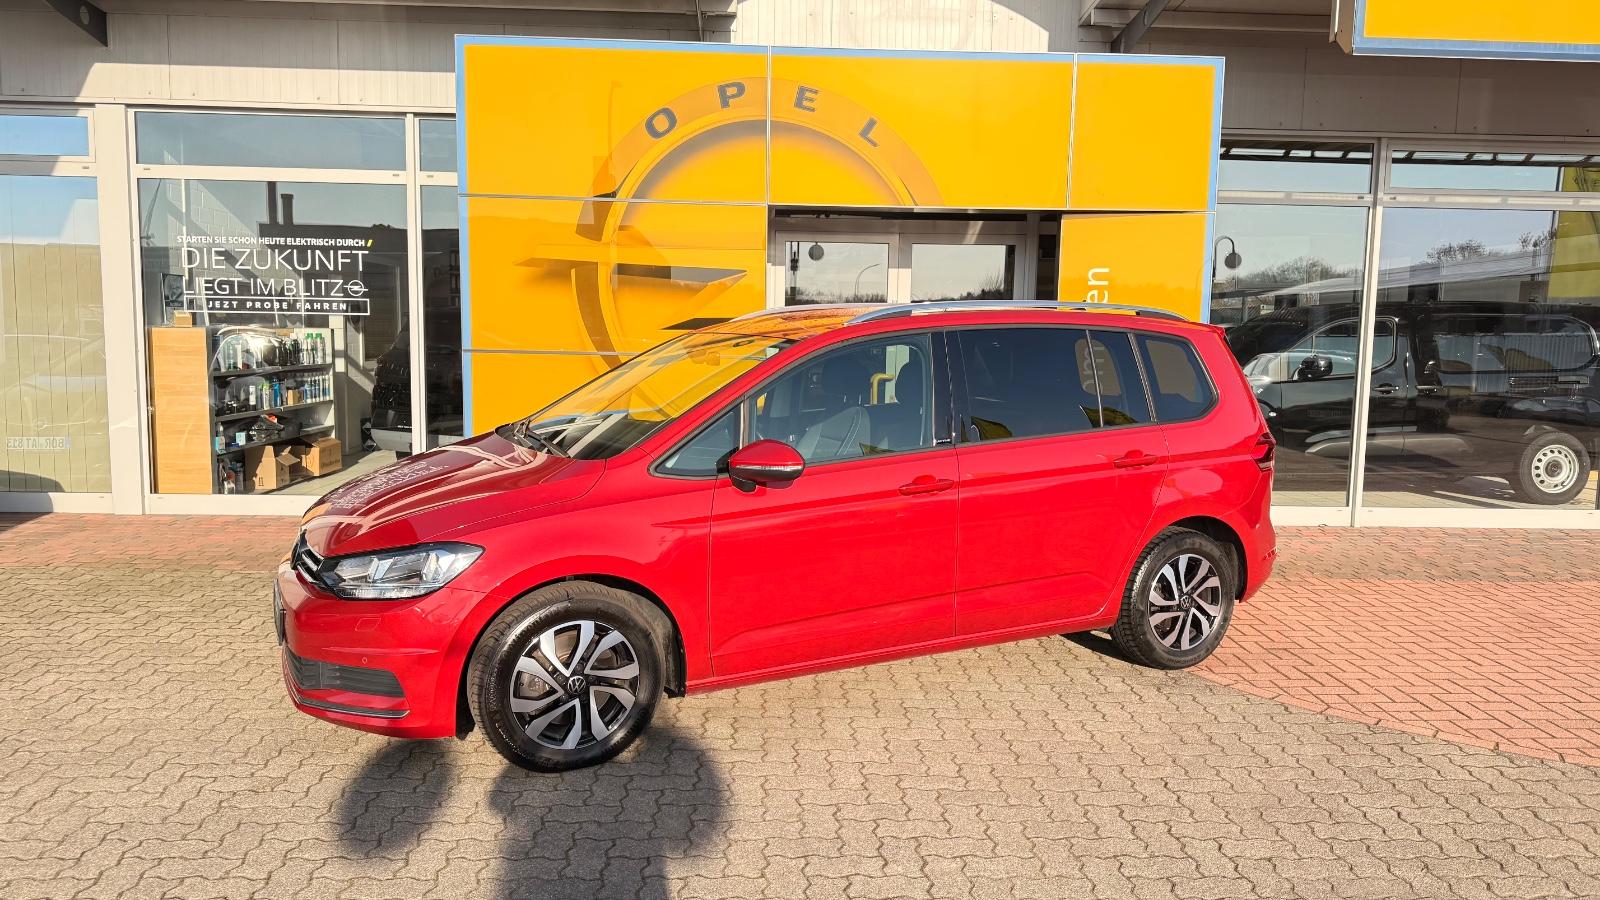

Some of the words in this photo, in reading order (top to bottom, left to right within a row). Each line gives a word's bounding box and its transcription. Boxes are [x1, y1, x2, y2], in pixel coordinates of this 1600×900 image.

[645, 81, 880, 148] OPEL
[214, 236, 227, 244] SIE
[259, 237, 286, 245] HEUTE
[287, 237, 335, 246] ELEKTRISCH
[336, 238, 365, 247] DURCH
[181, 247, 225, 269] DIE
[234, 248, 369, 272] ZUKUNFT
[182, 277, 243, 295] LIEGT
[250, 278, 275, 295] IM
[284, 278, 344, 297] BLITZ
[208, 300, 238, 309] JEZT
[247, 301, 288, 310] PROBE
[297, 302, 347, 311] FAHREN
[567, 675, 586, 694] VW
